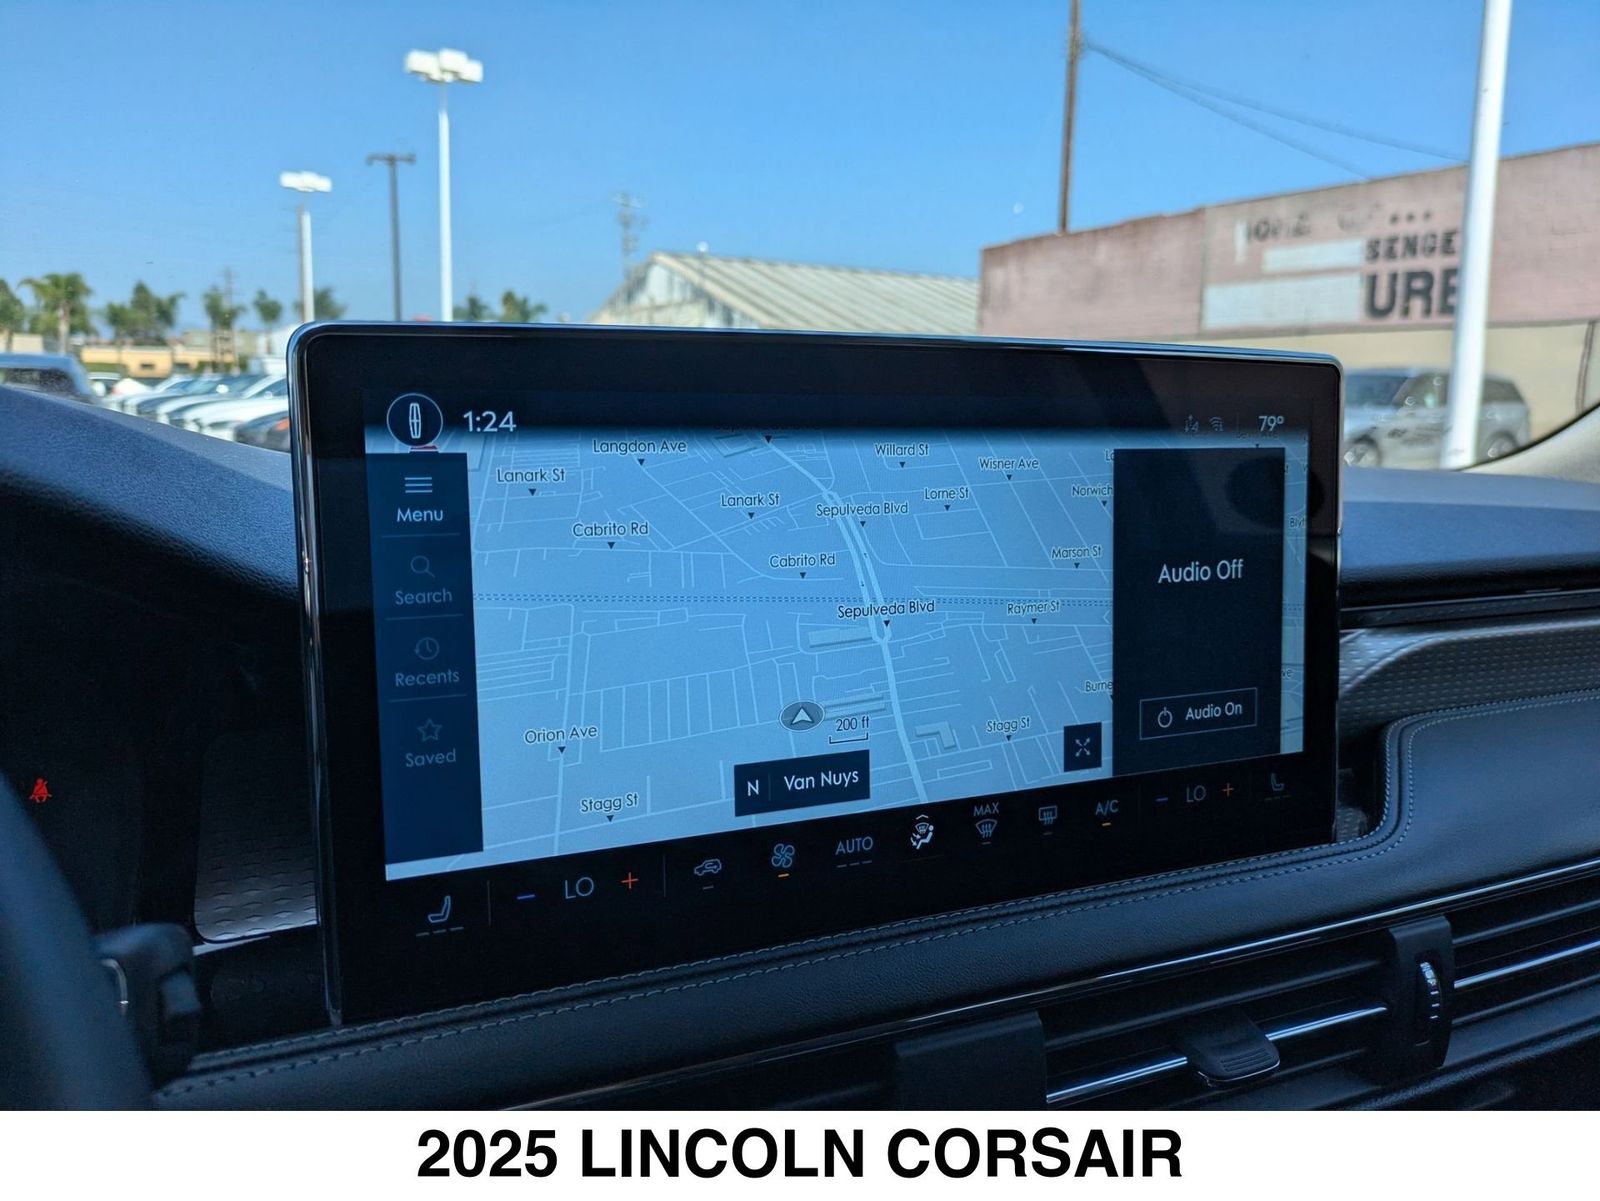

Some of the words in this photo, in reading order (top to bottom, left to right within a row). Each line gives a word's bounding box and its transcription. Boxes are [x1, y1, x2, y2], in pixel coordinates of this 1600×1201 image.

[463, 410, 517, 432] 1:24
[592, 439, 656, 456] Langdon
[659, 439, 687, 453] Ave
[875, 442, 915, 456] Willard
[917, 442, 930, 455] St
[979, 457, 1016, 470] Wisner
[1018, 457, 1039, 470] Ave
[497, 468, 547, 483] Lanark
[551, 468, 566, 482] St
[924, 487, 955, 500] Lorne
[956, 486, 969, 499] St
[1072, 484, 1113, 497] Norwich
[721, 493, 763, 507] Lanark
[767, 493, 780, 506] St
[396, 507, 444, 523] Menu
[816, 503, 880, 520] Sepulveda
[883, 502, 909, 515] Blvd
[572, 522, 626, 539] Cabrito
[628, 521, 649, 536] Rd
[769, 554, 816, 569] Cabrito
[819, 552, 836, 566] Rd
[1051, 546, 1090, 559] Marson
[1091, 545, 1102, 557] St
[1158, 560, 1211, 584] Audio
[1216, 559, 1244, 580] Off
[395, 588, 453, 606] Search
[837, 602, 906, 620] Sepulveda
[909, 600, 936, 615] Blvd
[1007, 602, 1048, 617] Raymer
[1050, 600, 1060, 613] St
[394, 668, 461, 688] Recents
[1185, 704, 1221, 721] Audio
[1224, 701, 1243, 716] On
[835, 716, 858, 732] 200
[861, 715, 870, 729] ft
[986, 718, 1018, 734] Stagg
[1019, 716, 1031, 729] St
[524, 728, 566, 745] Orion
[570, 725, 598, 740] Ave
[405, 748, 457, 768] Saved
[747, 779, 760, 797] N
[784, 774, 815, 791] Van
[820, 769, 860, 788] Nuys
[1186, 784, 1206, 803] LO
[580, 796, 623, 814] Stagg
[625, 793, 639, 808] St
[973, 801, 1000, 818] MAX
[1095, 800, 1120, 816] A/C
[835, 835, 874, 856] AUTO
[564, 876, 596, 900] LO
